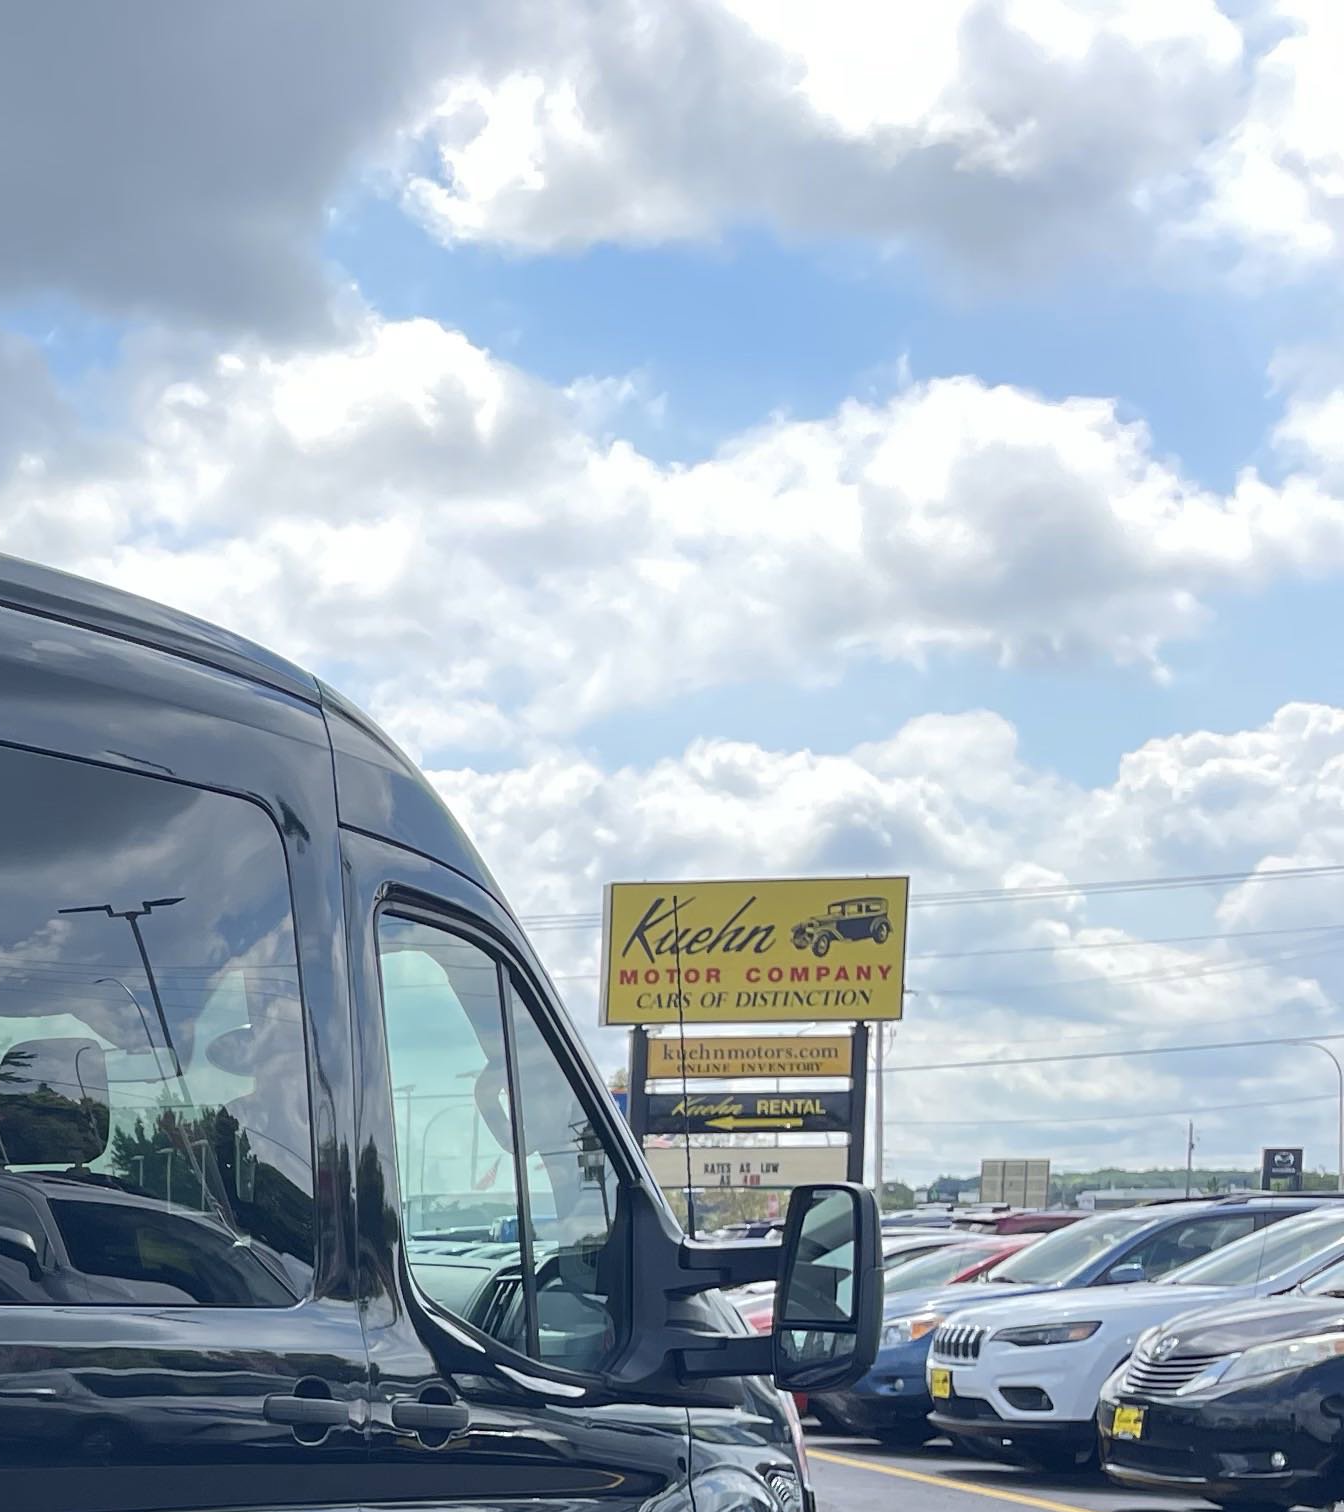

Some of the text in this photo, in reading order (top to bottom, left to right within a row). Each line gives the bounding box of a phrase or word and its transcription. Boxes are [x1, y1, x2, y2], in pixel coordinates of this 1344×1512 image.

[622, 896, 776, 963] Kuehn
[619, 965, 893, 985] MOTOR COMPANY
[636, 989, 873, 1009] CARS OF DISTINCTION
[663, 1043, 839, 1060] kuehnmotors.com
[677, 1061, 823, 1073] ONLINE INVENTORY
[671, 1096, 826, 1116] Kuehn RENTAL
[704, 1162, 780, 1174] RATES AS LOW
